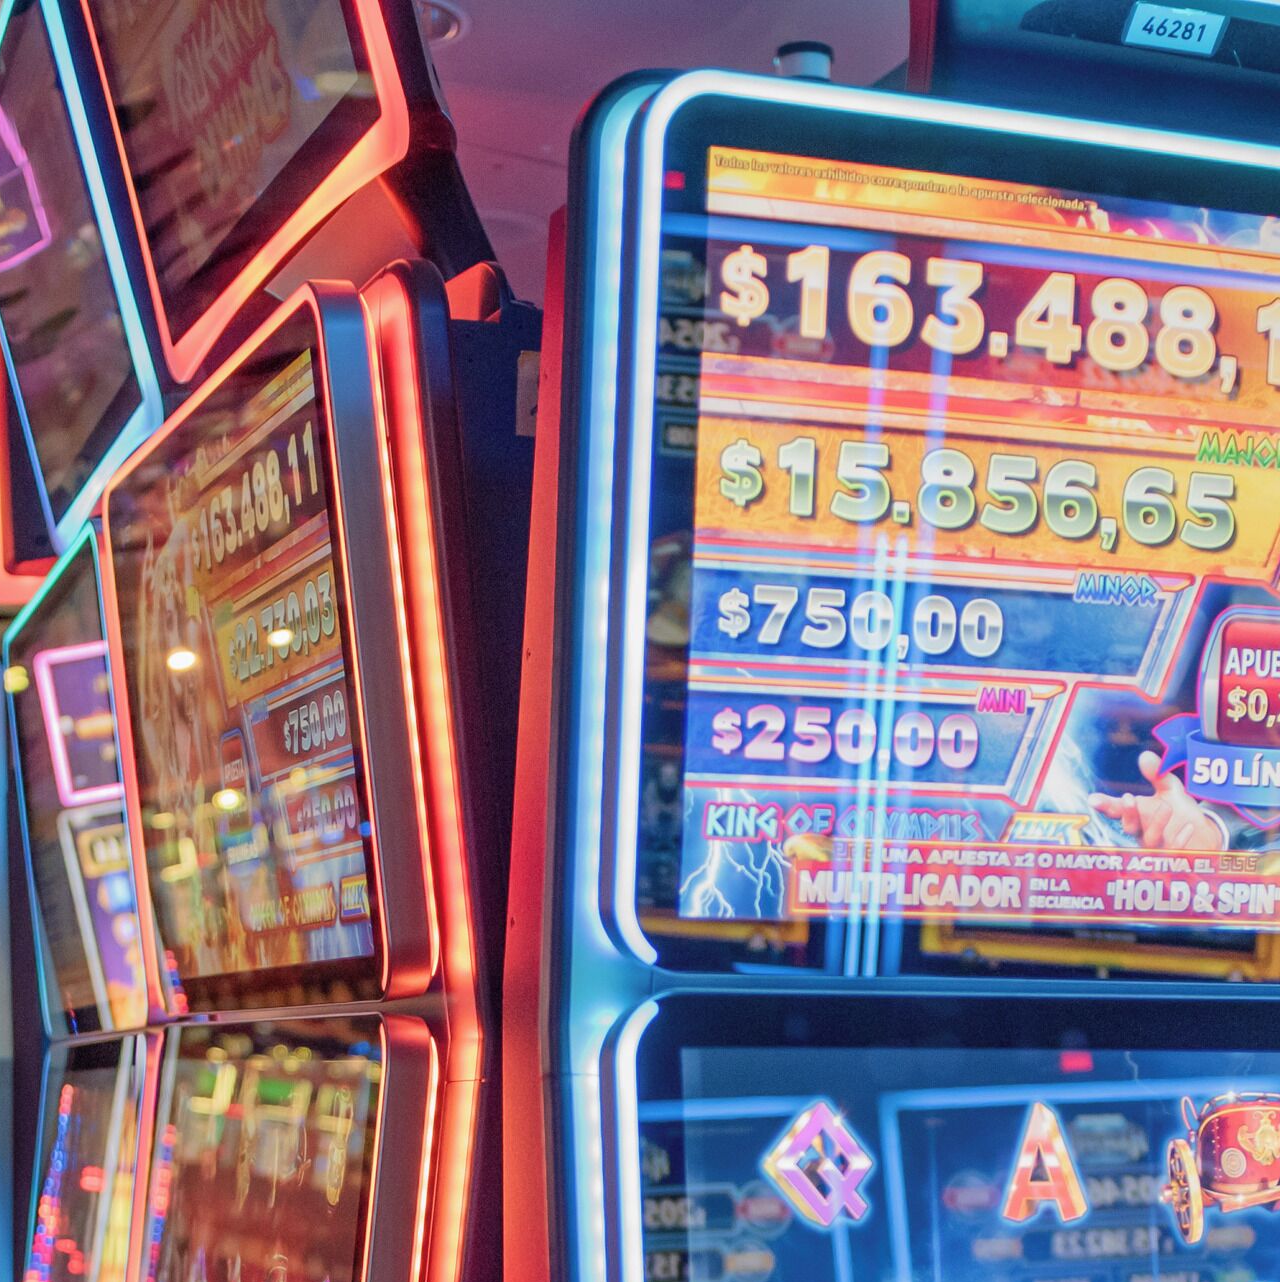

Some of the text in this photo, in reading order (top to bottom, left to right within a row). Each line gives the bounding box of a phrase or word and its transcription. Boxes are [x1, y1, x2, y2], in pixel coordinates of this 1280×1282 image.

[1141, 15, 1207, 42] 46281
[713, 154, 750, 171] Todos
[751, 159, 769, 173] los
[770, 163, 813, 179] valores
[814, 167, 870, 185] exhibidos
[871, 173, 952, 194] corresponden
[971, 188, 1014, 202] apuesta
[1017, 192, 1088, 211] seleccionada.
[191, 420, 318, 570] $163.488,11
[720, 436, 1237, 552] $15.856,65
[718, 584, 1004, 662] $750,00
[977, 686, 1027, 716] MINI
[283, 690, 347, 755] $750,00
[711, 704, 979, 771] $250,00
[1192, 756, 1228, 786] 50
[706, 803, 779, 840] KING
[787, 808, 832, 835] OF
[882, 848, 922, 865] UNA
[926, 849, 1011, 868] APUESTA
[1038, 854, 1052, 869] O
[1056, 854, 1123, 871] MAYOR
[1126, 856, 1191, 874] ACTIVA
[1194, 858, 1215, 874] EL
[798, 870, 1022, 908] MULTIPLICADOR
[1028, 895, 1105, 911] SECUENCIA
[1029, 877, 1071, 892] EN LA
[1192, 882, 1215, 914] &
[1002, 1101, 1088, 1223] A
